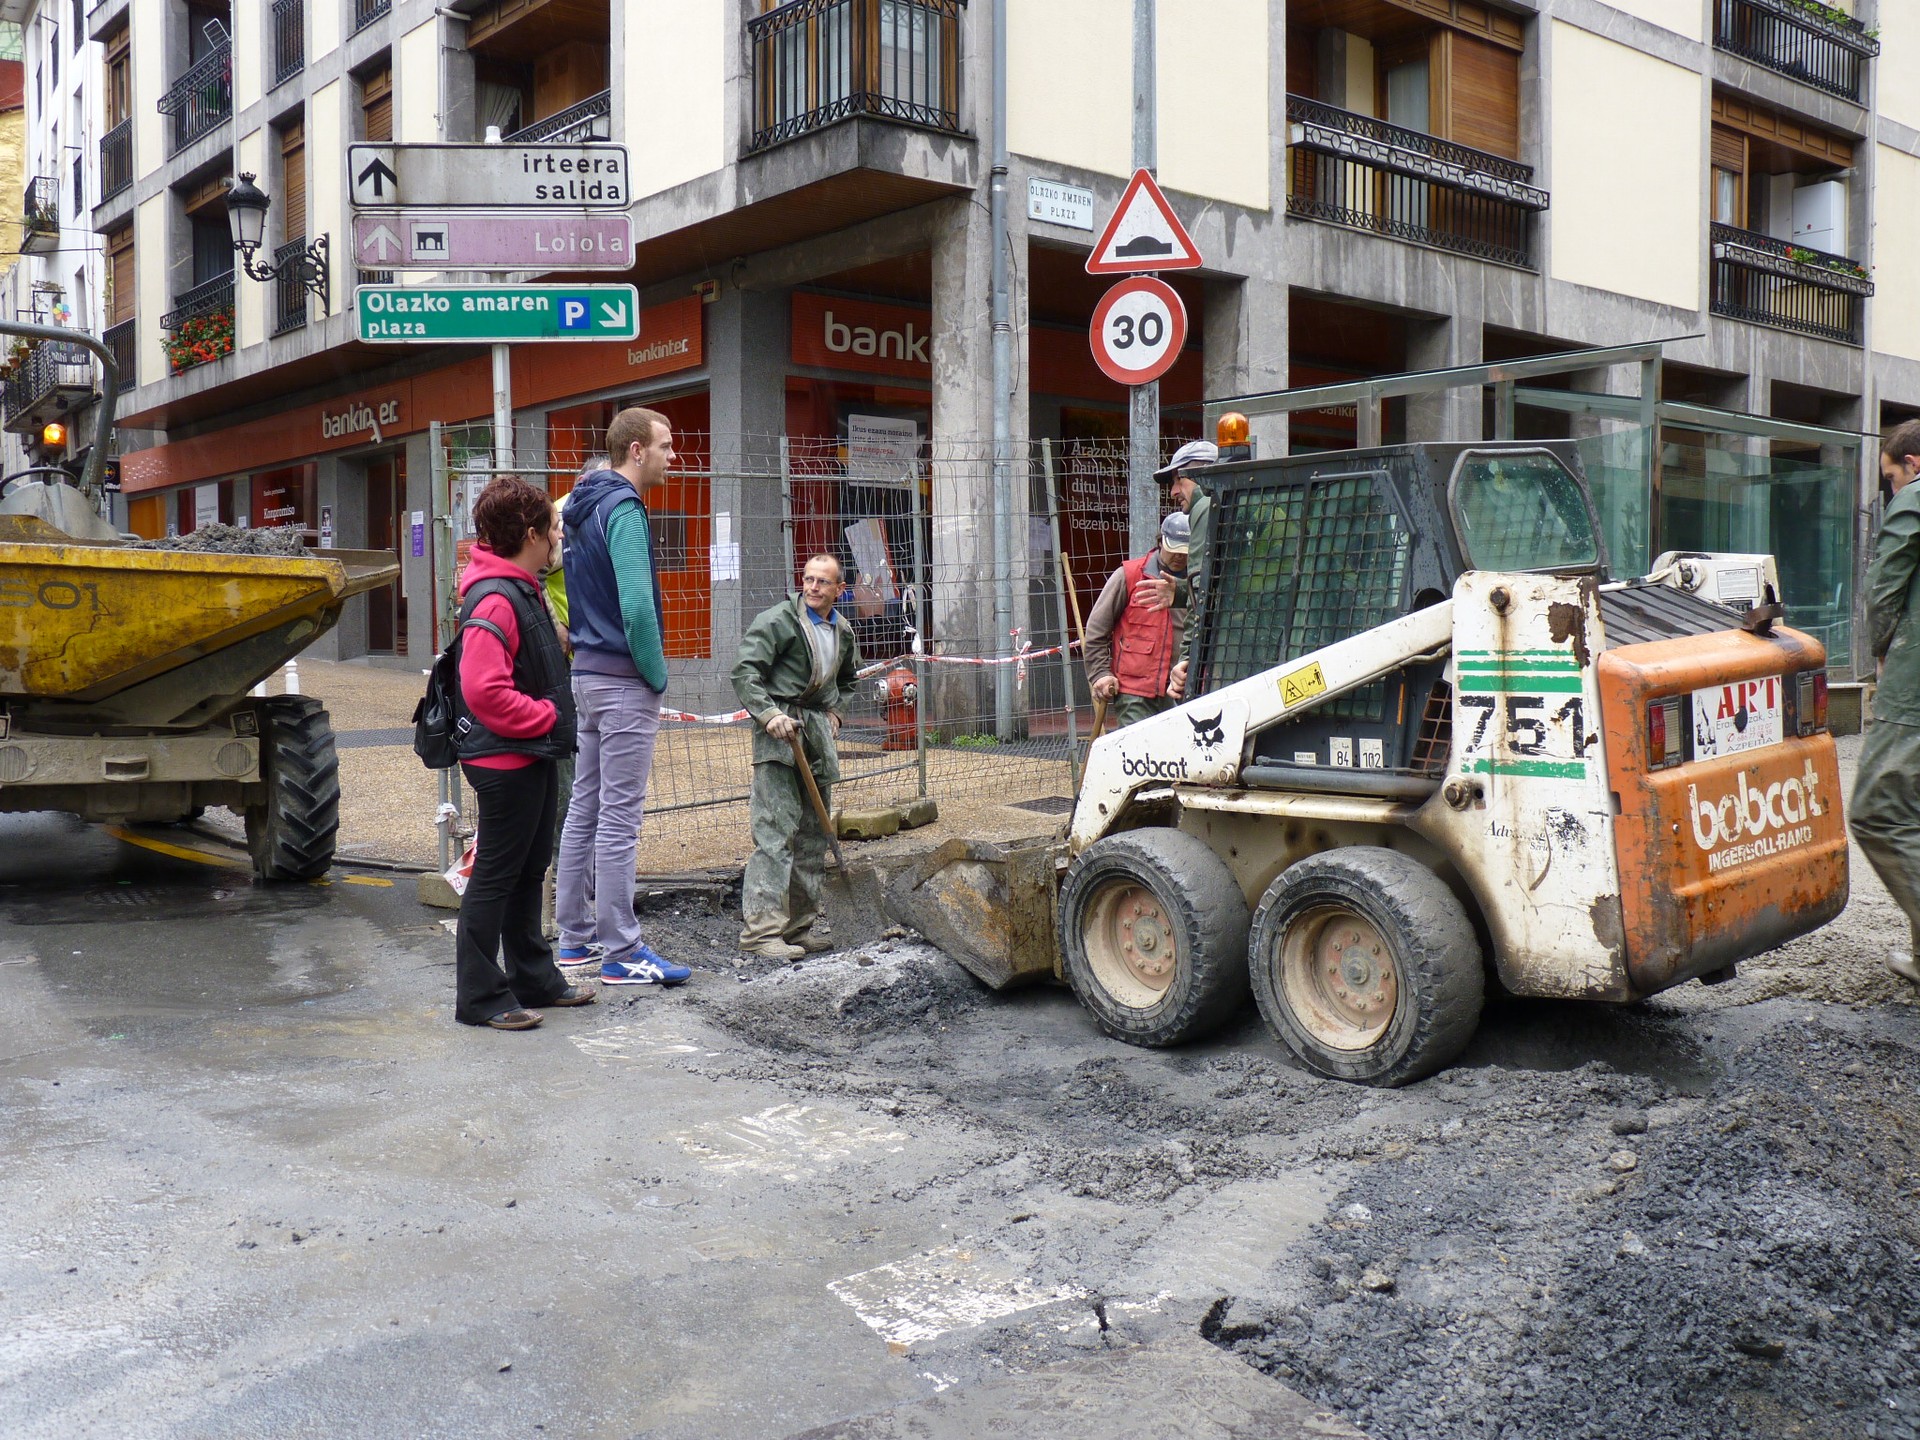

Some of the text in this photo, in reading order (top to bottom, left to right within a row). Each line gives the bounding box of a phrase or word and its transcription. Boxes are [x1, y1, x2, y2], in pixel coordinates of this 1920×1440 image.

[522, 153, 619, 174] irteera
[535, 180, 621, 200] salida
[1030, 185, 1092, 207] OLAZKO AMAREN
[1050, 206, 1077, 220] PLAZA
[535, 231, 624, 252] Loiola
[366, 293, 549, 313] Olazko amaren
[564, 301, 585, 327] P
[367, 319, 427, 338] plaza
[824, 311, 932, 363] bank
[1112, 312, 1164, 350] 30
[71, 353, 86, 363] dut
[852, 425, 867, 433] Ikus
[867, 427, 887, 435] ezazu
[1071, 442, 1108, 458] Arazo
[1071, 459, 1119, 478] hainbat
[1102, 480, 1129, 496] bain
[263, 504, 296, 521] Kompromiso
[1071, 496, 1118, 514] bakarra
[1071, 514, 1130, 532] bezero bak
[1717, 676, 1780, 720] ART
[1459, 695, 1585, 759] 751
[1726, 736, 1774, 753] AZPEITIA
[1122, 752, 1189, 779] bobcat
[1336, 750, 1349, 766] 84
[1362, 752, 1382, 768] 102
[1687, 758, 1822, 850] bobcat
